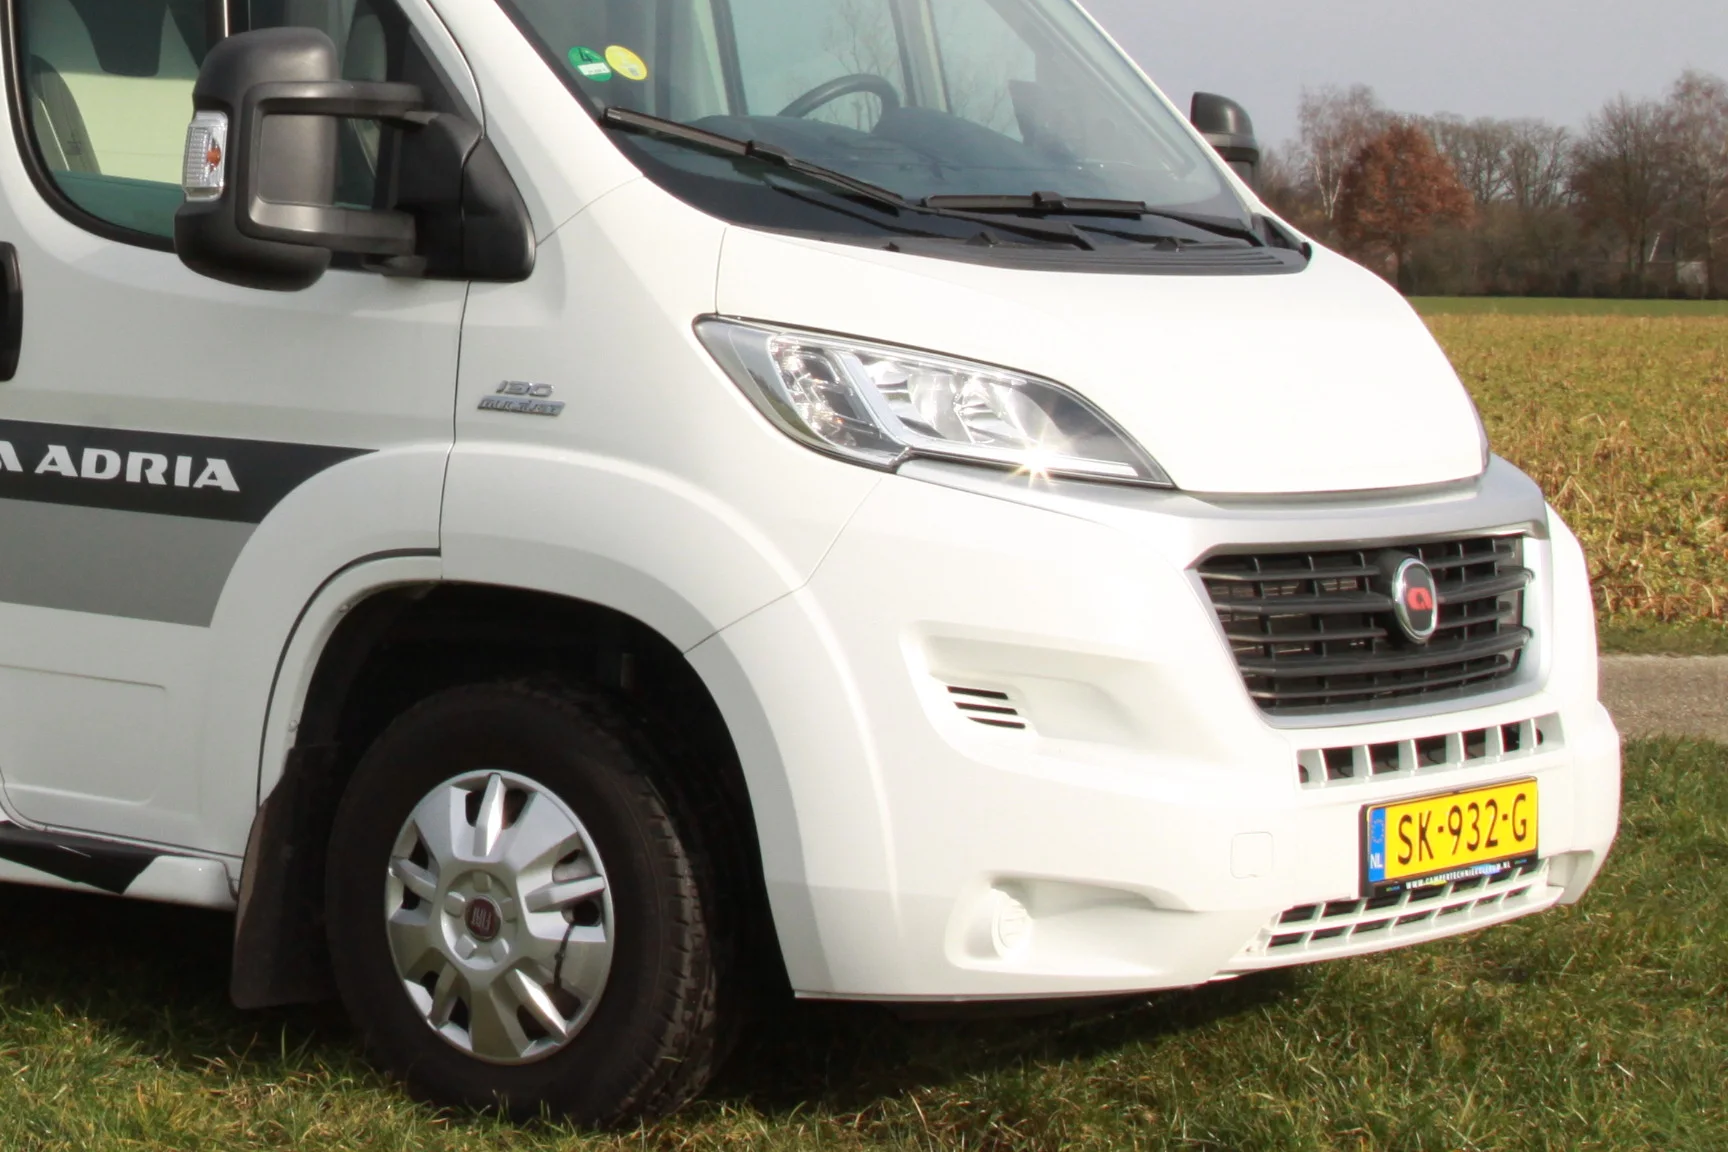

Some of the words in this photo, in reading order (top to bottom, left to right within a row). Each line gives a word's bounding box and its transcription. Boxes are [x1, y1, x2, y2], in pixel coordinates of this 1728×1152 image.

[34, 444, 241, 492] ADRIA
[1397, 792, 1527, 865] SK-932-G
[1370, 853, 1383, 869] NL
